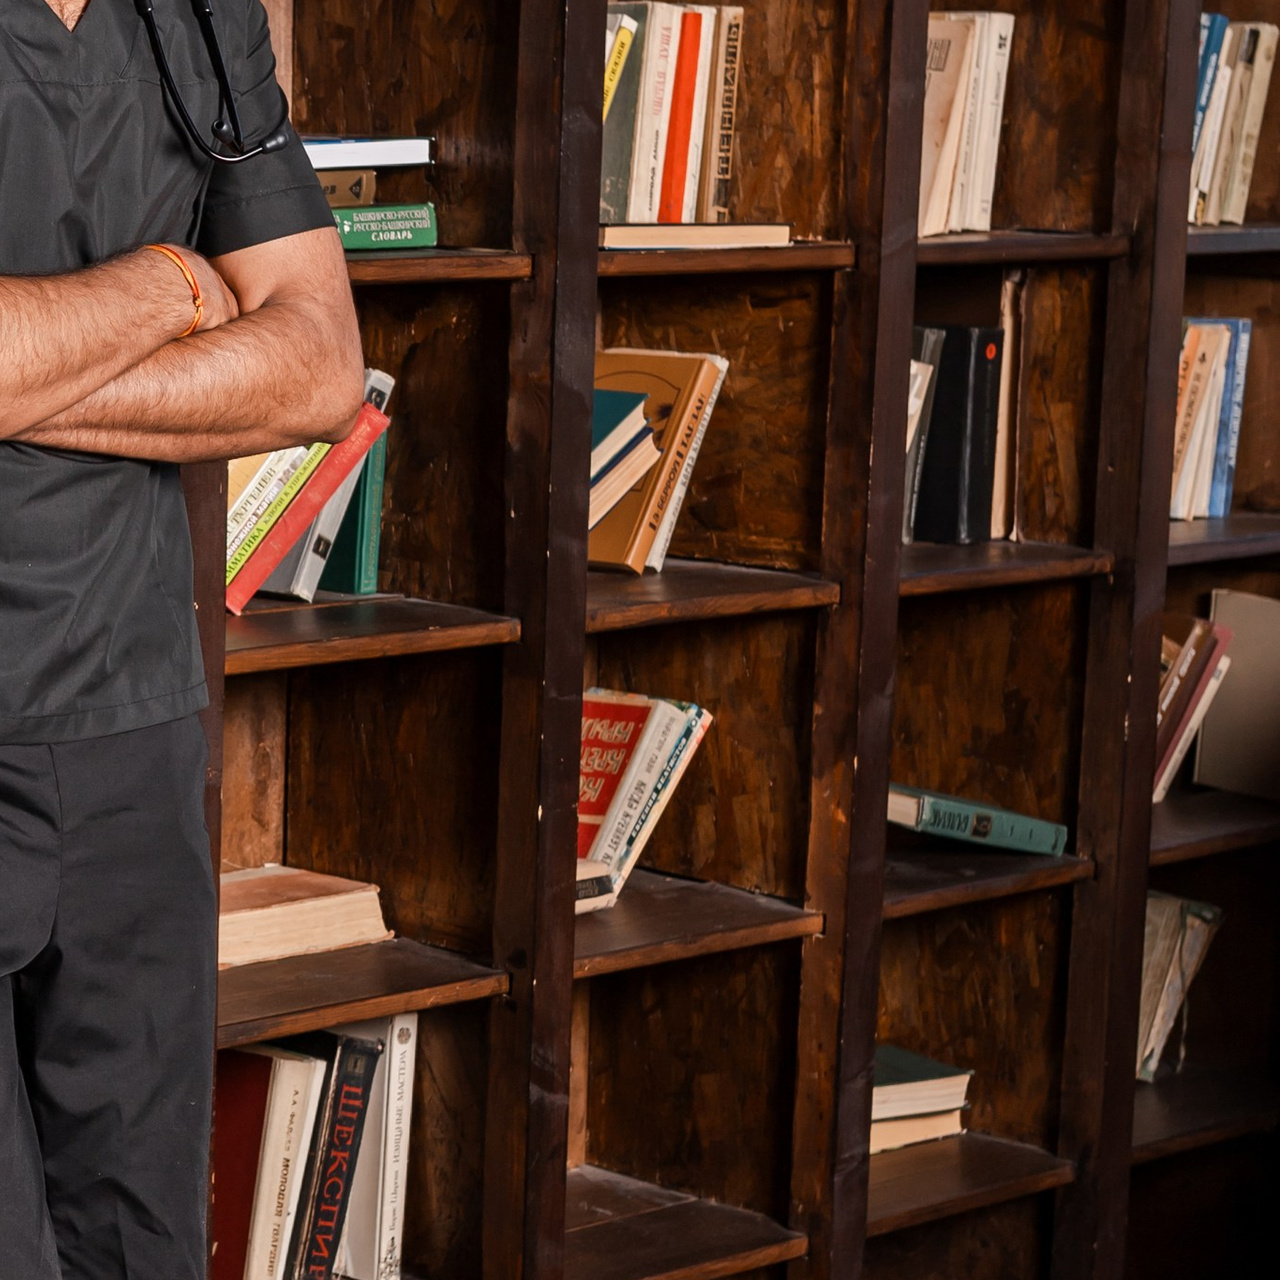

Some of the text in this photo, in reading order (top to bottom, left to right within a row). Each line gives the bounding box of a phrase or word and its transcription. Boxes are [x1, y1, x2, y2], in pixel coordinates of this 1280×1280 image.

[657, 25, 673, 65] ДУША
[714, 22, 741, 208] ТЕНДАЛЬ
[371, 230, 413, 242] СЛОВАРЬ
[232, 466, 278, 526] ТУРГЕНЕВ
[256, 484, 281, 517] магии
[262, 496, 285, 525] КЛЮЧИ
[630, 736, 688, 839] ЕВГЕНИЙ ВЕЛТИСТОВ
[397, 1048, 408, 1103] МАСТЕРА
[392, 1105, 404, 1164] ИЗЯЩНЫЕ
[274, 1156, 291, 1219] МОЛОДАЯ
[267, 1222, 281, 1278] ГВАРДИЯ
